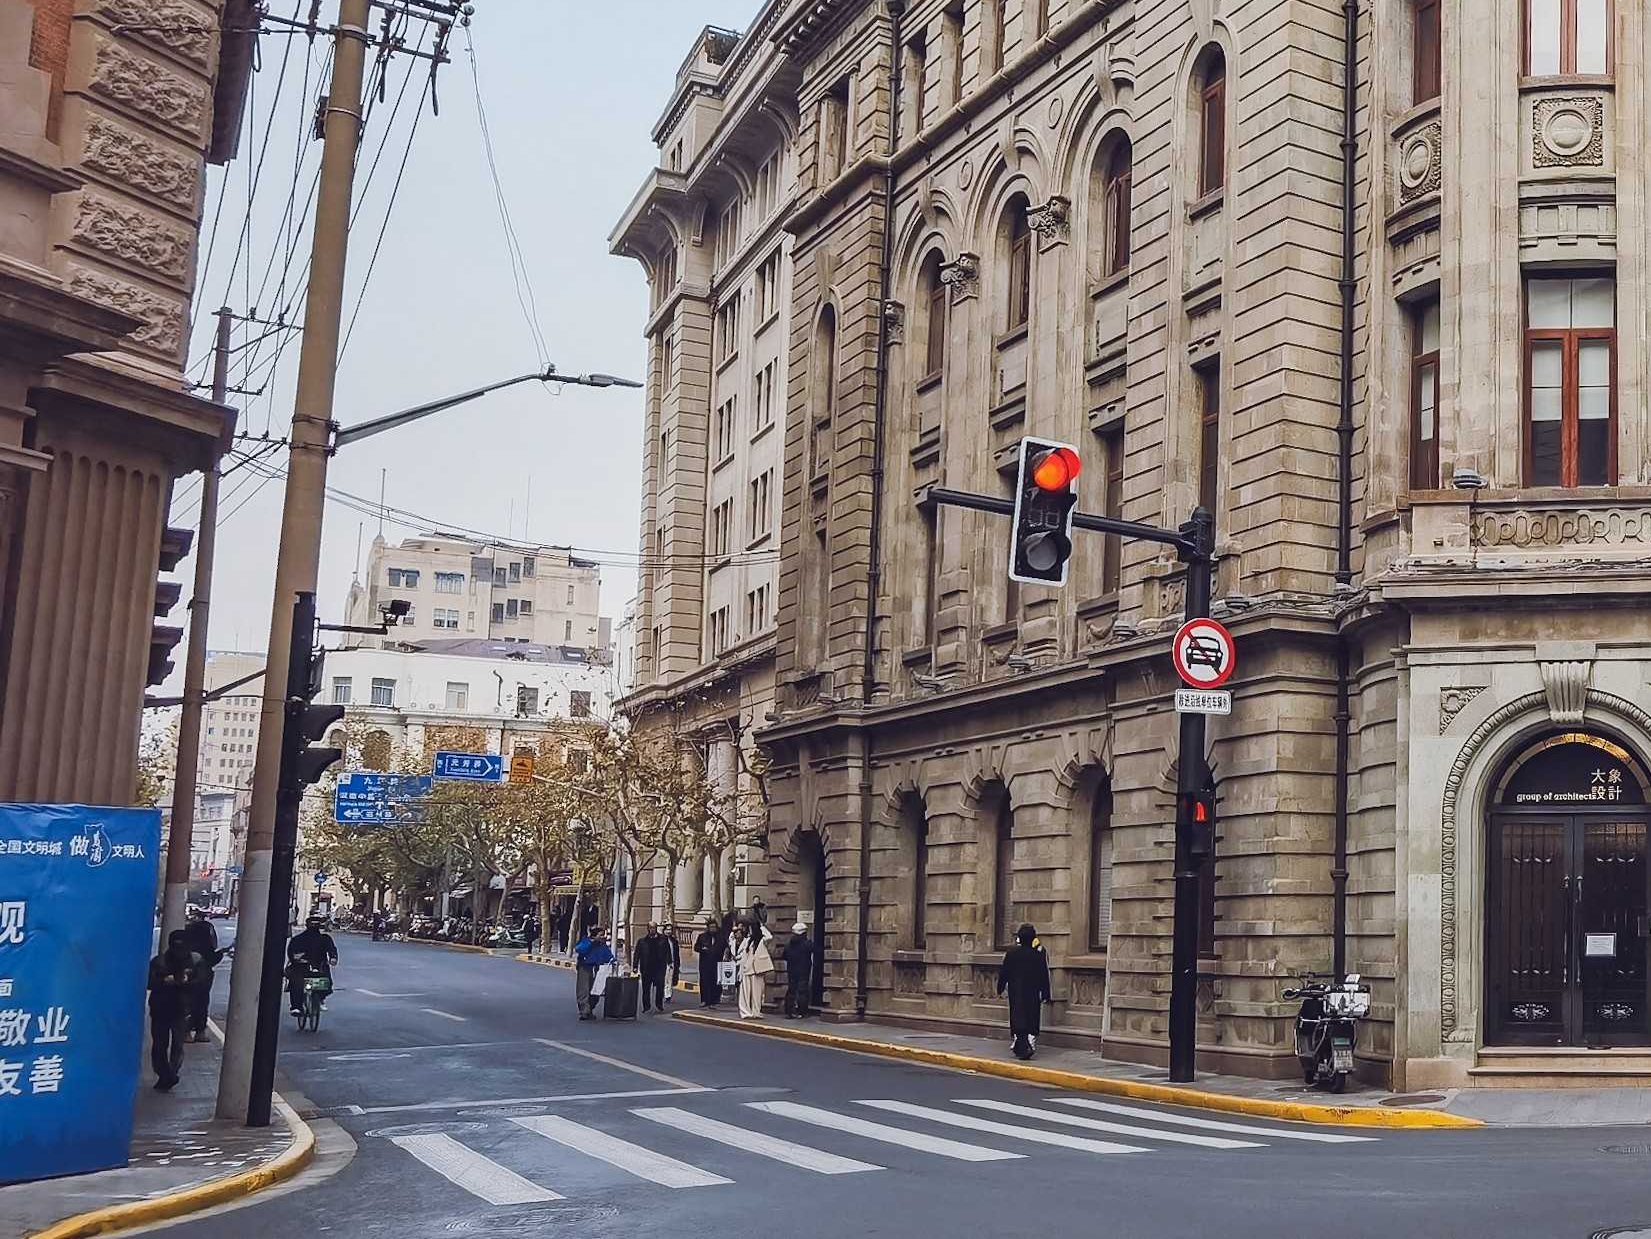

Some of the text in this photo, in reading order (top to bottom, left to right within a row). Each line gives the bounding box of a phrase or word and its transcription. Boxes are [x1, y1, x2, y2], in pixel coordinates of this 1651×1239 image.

[1591, 768, 1622, 783] 大象
[1516, 793, 1541, 802] group
[1543, 792, 1552, 800] of
[1591, 785, 1622, 801] 設計
